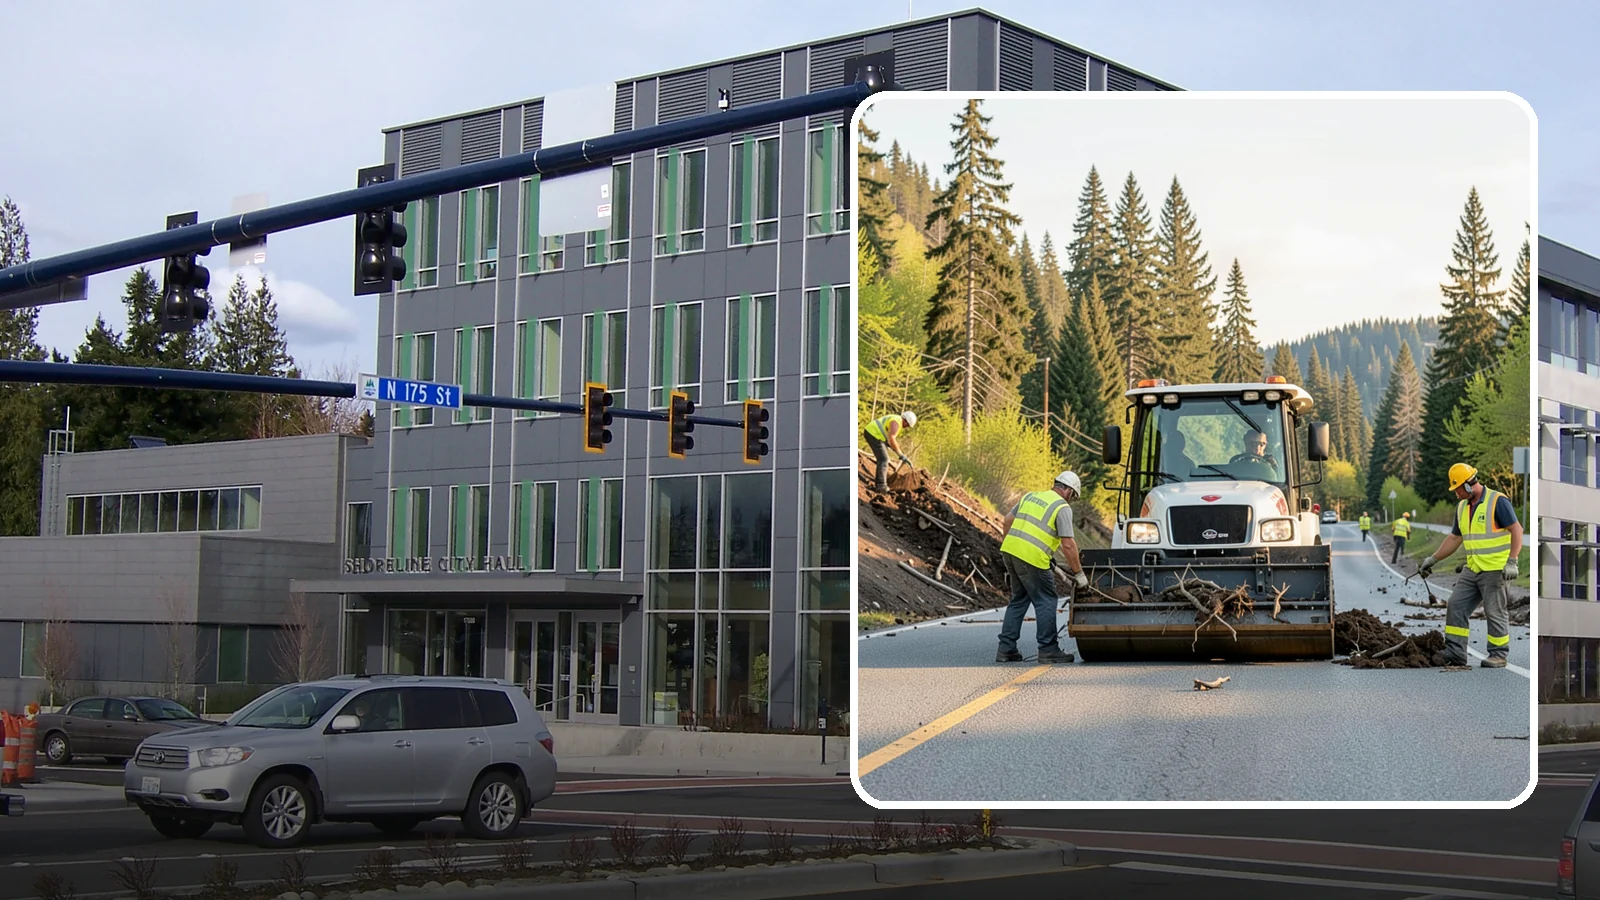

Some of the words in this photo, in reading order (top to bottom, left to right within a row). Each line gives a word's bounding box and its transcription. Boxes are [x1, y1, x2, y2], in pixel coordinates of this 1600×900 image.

[387, 380, 396, 400] N
[405, 382, 428, 403] 175
[436, 386, 452, 406] St
[343, 557, 431, 574] SHORELINE
[438, 556, 476, 572] CITY
[484, 555, 525, 572] HALL
